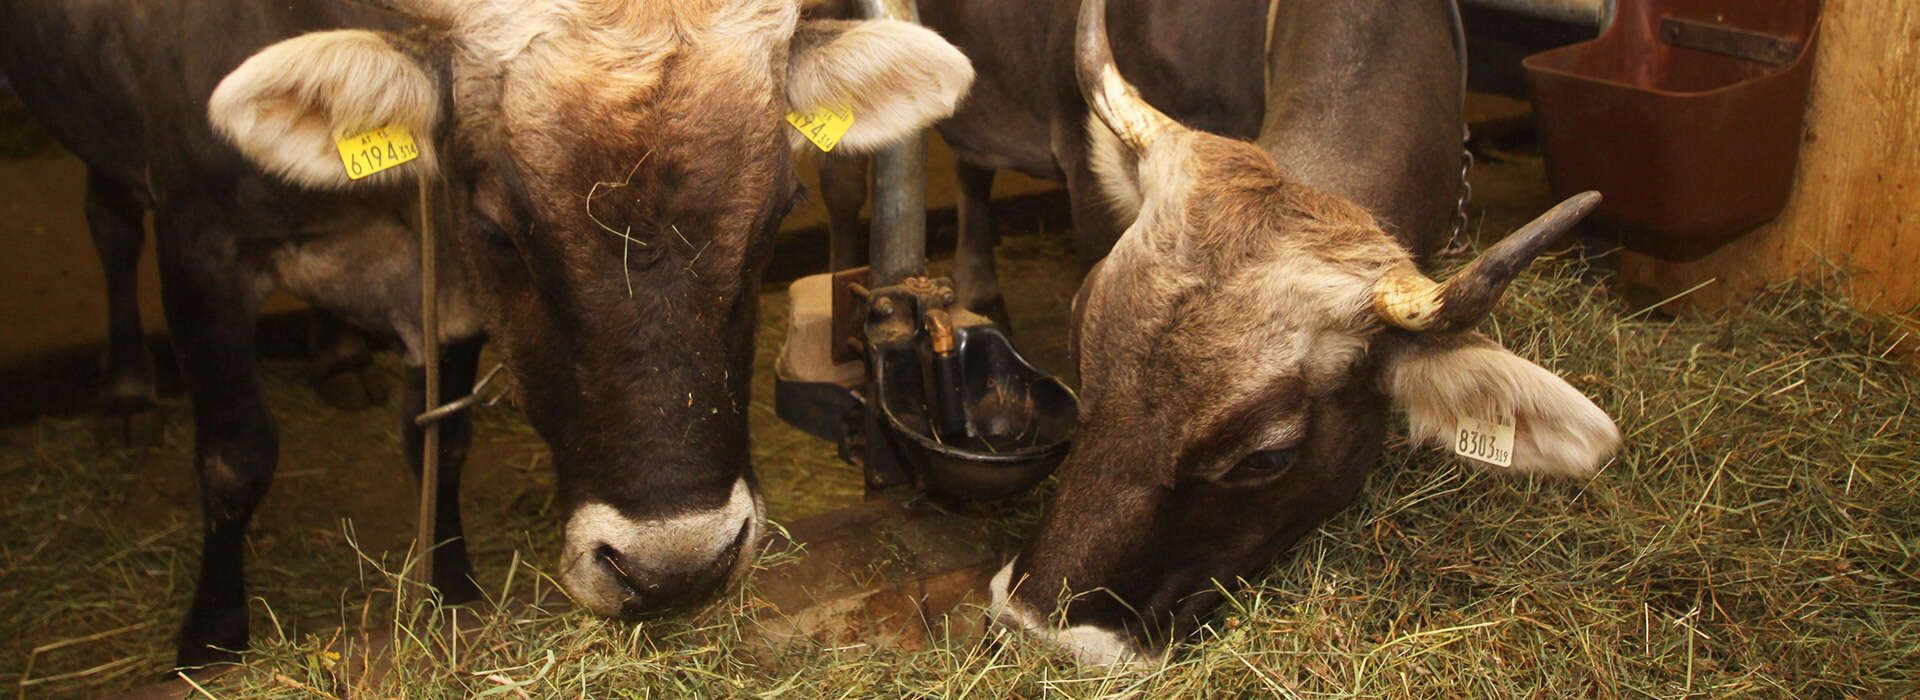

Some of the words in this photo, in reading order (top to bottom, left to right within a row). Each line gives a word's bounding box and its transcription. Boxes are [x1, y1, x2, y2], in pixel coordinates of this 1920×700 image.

[351, 141, 398, 176] 6194
[1459, 428, 1496, 459] 8303
[1495, 448, 1509, 463] 319
